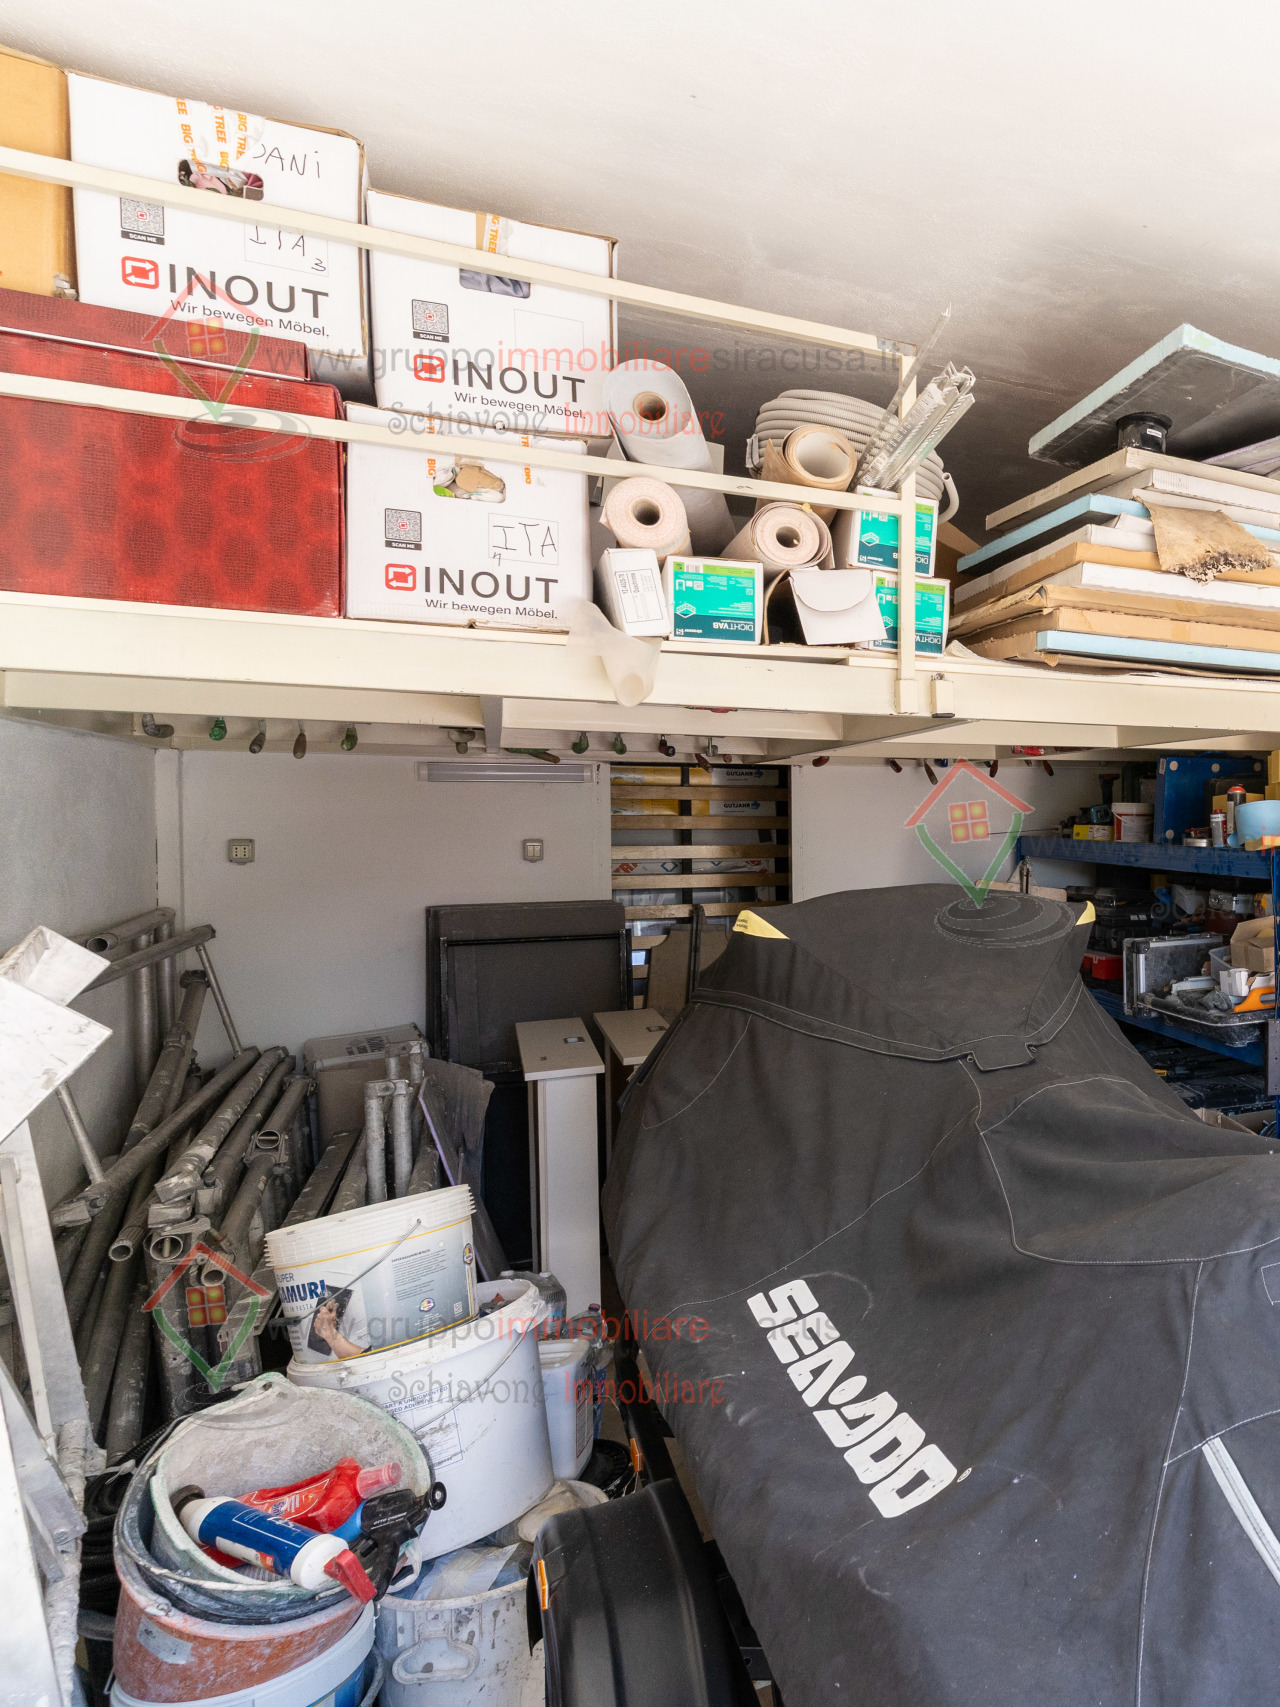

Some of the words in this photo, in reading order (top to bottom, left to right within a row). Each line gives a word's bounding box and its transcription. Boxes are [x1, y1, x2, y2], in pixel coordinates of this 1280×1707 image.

[181, 123, 194, 144] BIG
[214, 115, 227, 143] TREE
[237, 113, 248, 132] BIG
[129, 233, 146, 241] SCAN
[168, 263, 330, 319] INOUT
[171, 299, 198, 314] Wir
[202, 304, 274, 328] bewegen
[279, 318, 330, 337] Möbel.
[419, 333, 433, 341] SCAN
[452, 359, 586, 403] INOUT
[454, 391, 478, 404] Wir
[480, 395, 541, 414] bewegen
[543, 403, 586, 419] Möbel.
[427, 458, 437, 477] BIG
[492, 522, 557, 557] ITA
[424, 566, 559, 604] INOUT
[425, 598, 448, 609] Wir
[451, 600, 512, 616] bewegen
[515, 606, 558, 619] Möbel.
